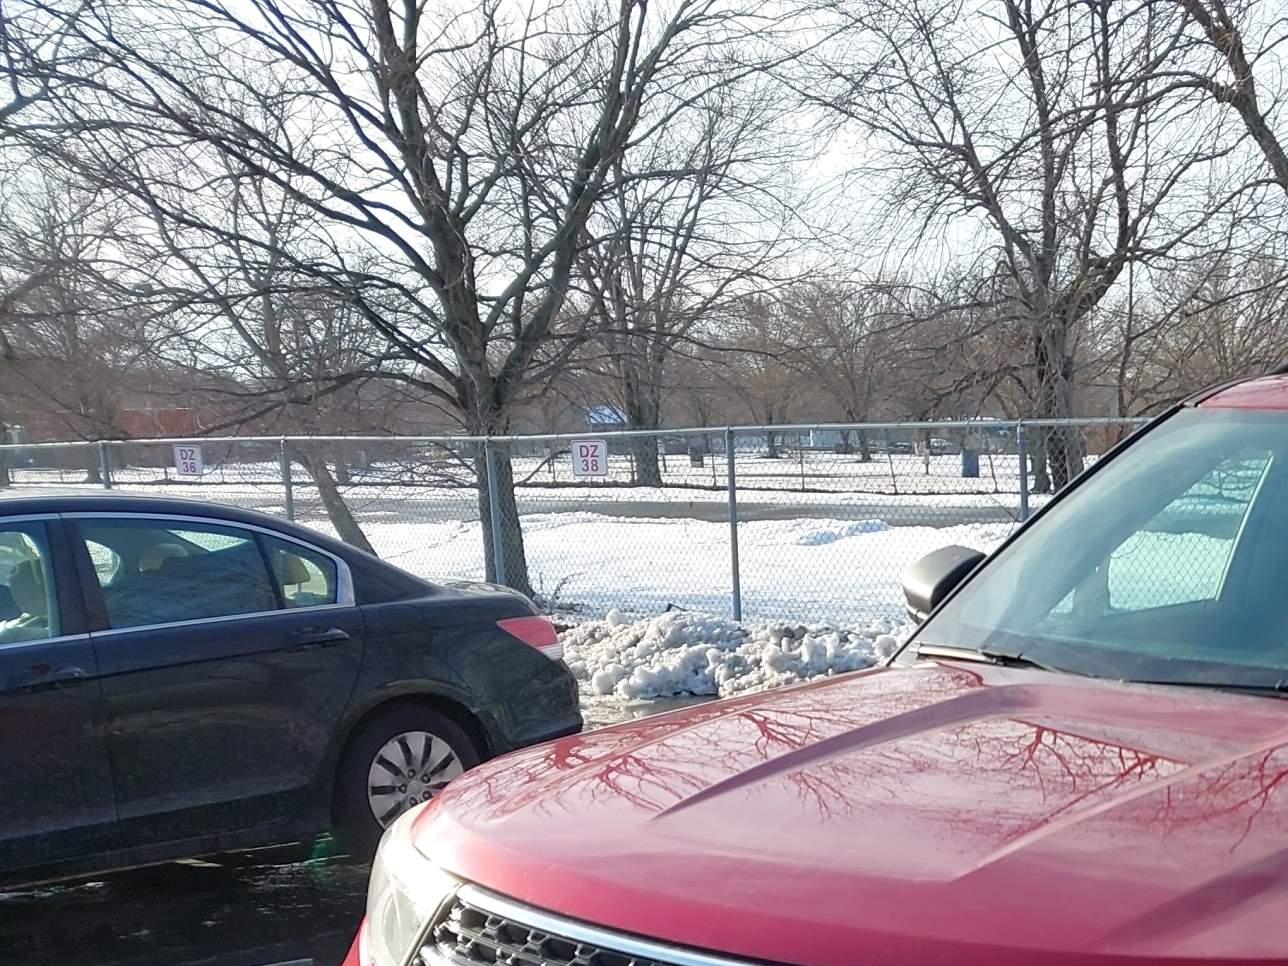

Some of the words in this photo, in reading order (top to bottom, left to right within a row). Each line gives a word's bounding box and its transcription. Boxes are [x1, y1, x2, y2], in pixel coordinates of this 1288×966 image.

[180, 449, 196, 460] DZ
[579, 445, 599, 458] DZ
[183, 461, 196, 473] 36
[581, 458, 599, 472] 38
